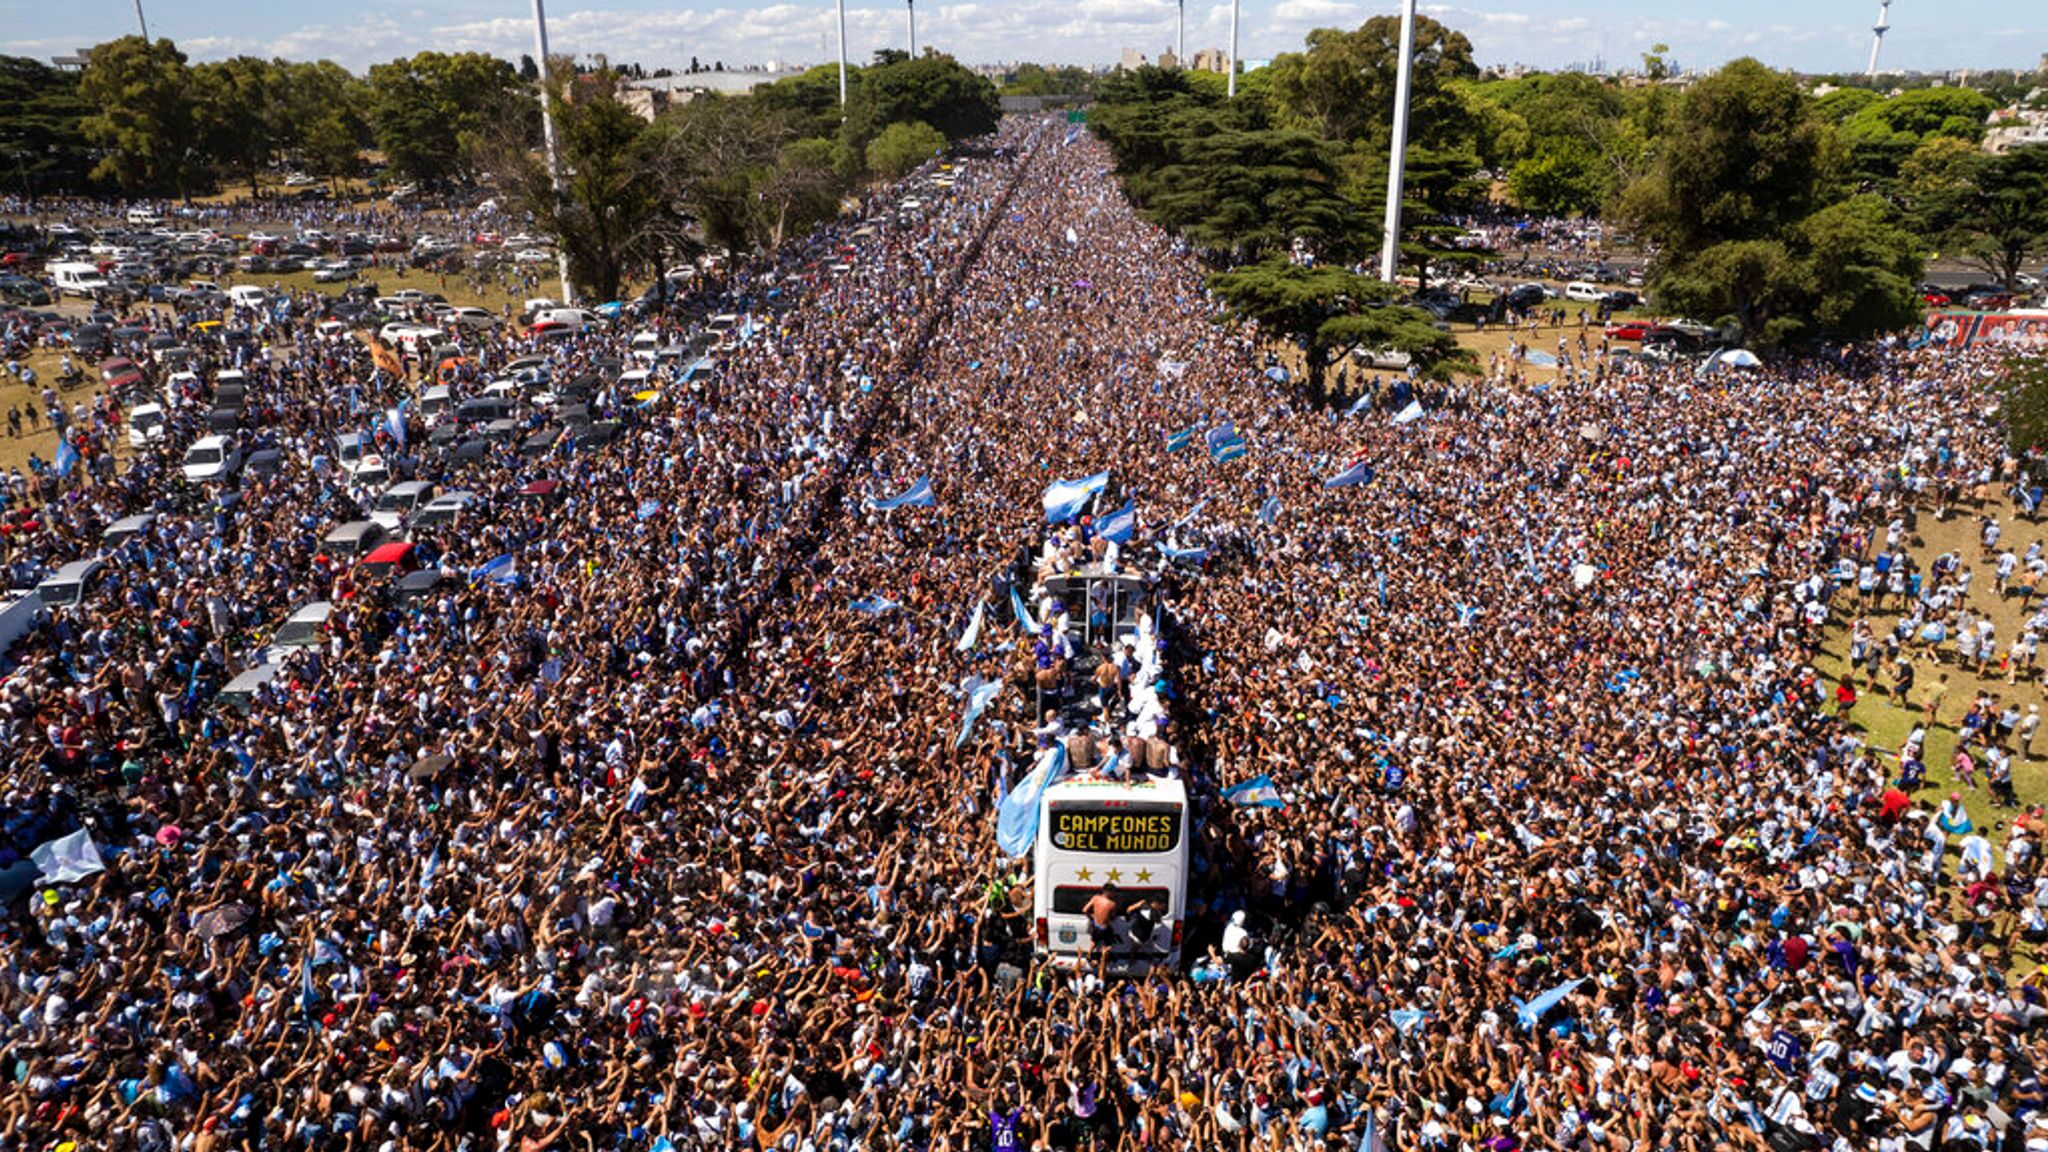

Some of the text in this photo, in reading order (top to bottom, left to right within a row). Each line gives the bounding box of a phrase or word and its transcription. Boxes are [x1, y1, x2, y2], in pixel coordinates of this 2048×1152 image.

[1059, 815, 1172, 832] CAMPEONES
[1065, 833, 1170, 849] DEL MUNDO
[1772, 1042, 1788, 1058] 10
[996, 1130, 1013, 1147] 10
